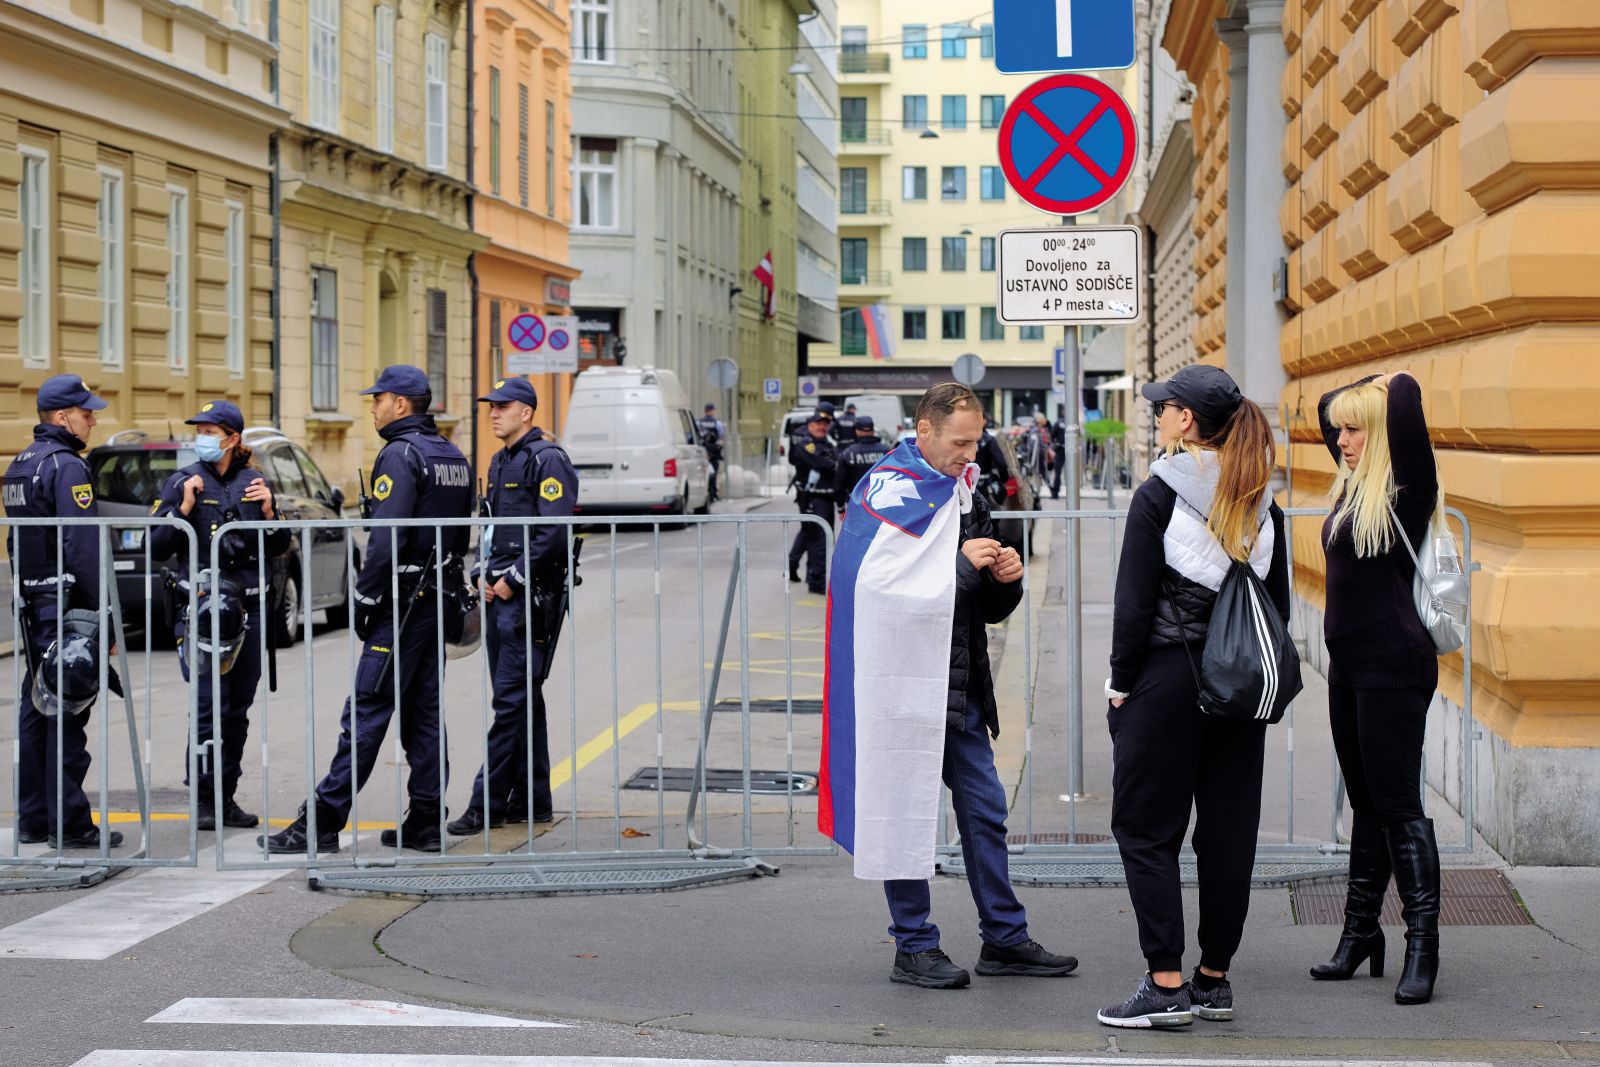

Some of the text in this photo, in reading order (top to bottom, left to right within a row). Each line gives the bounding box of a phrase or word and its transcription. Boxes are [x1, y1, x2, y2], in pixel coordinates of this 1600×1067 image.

[1026, 259, 1110, 274] Dovoljeno za
[1006, 275, 1133, 292] USTAVNO SODIŠČE
[1042, 299, 1050, 310] 4
[1054, 299, 1062, 310] P
[1066, 299, 1104, 311] mesta
[434, 463, 470, 487] POLICIJA
